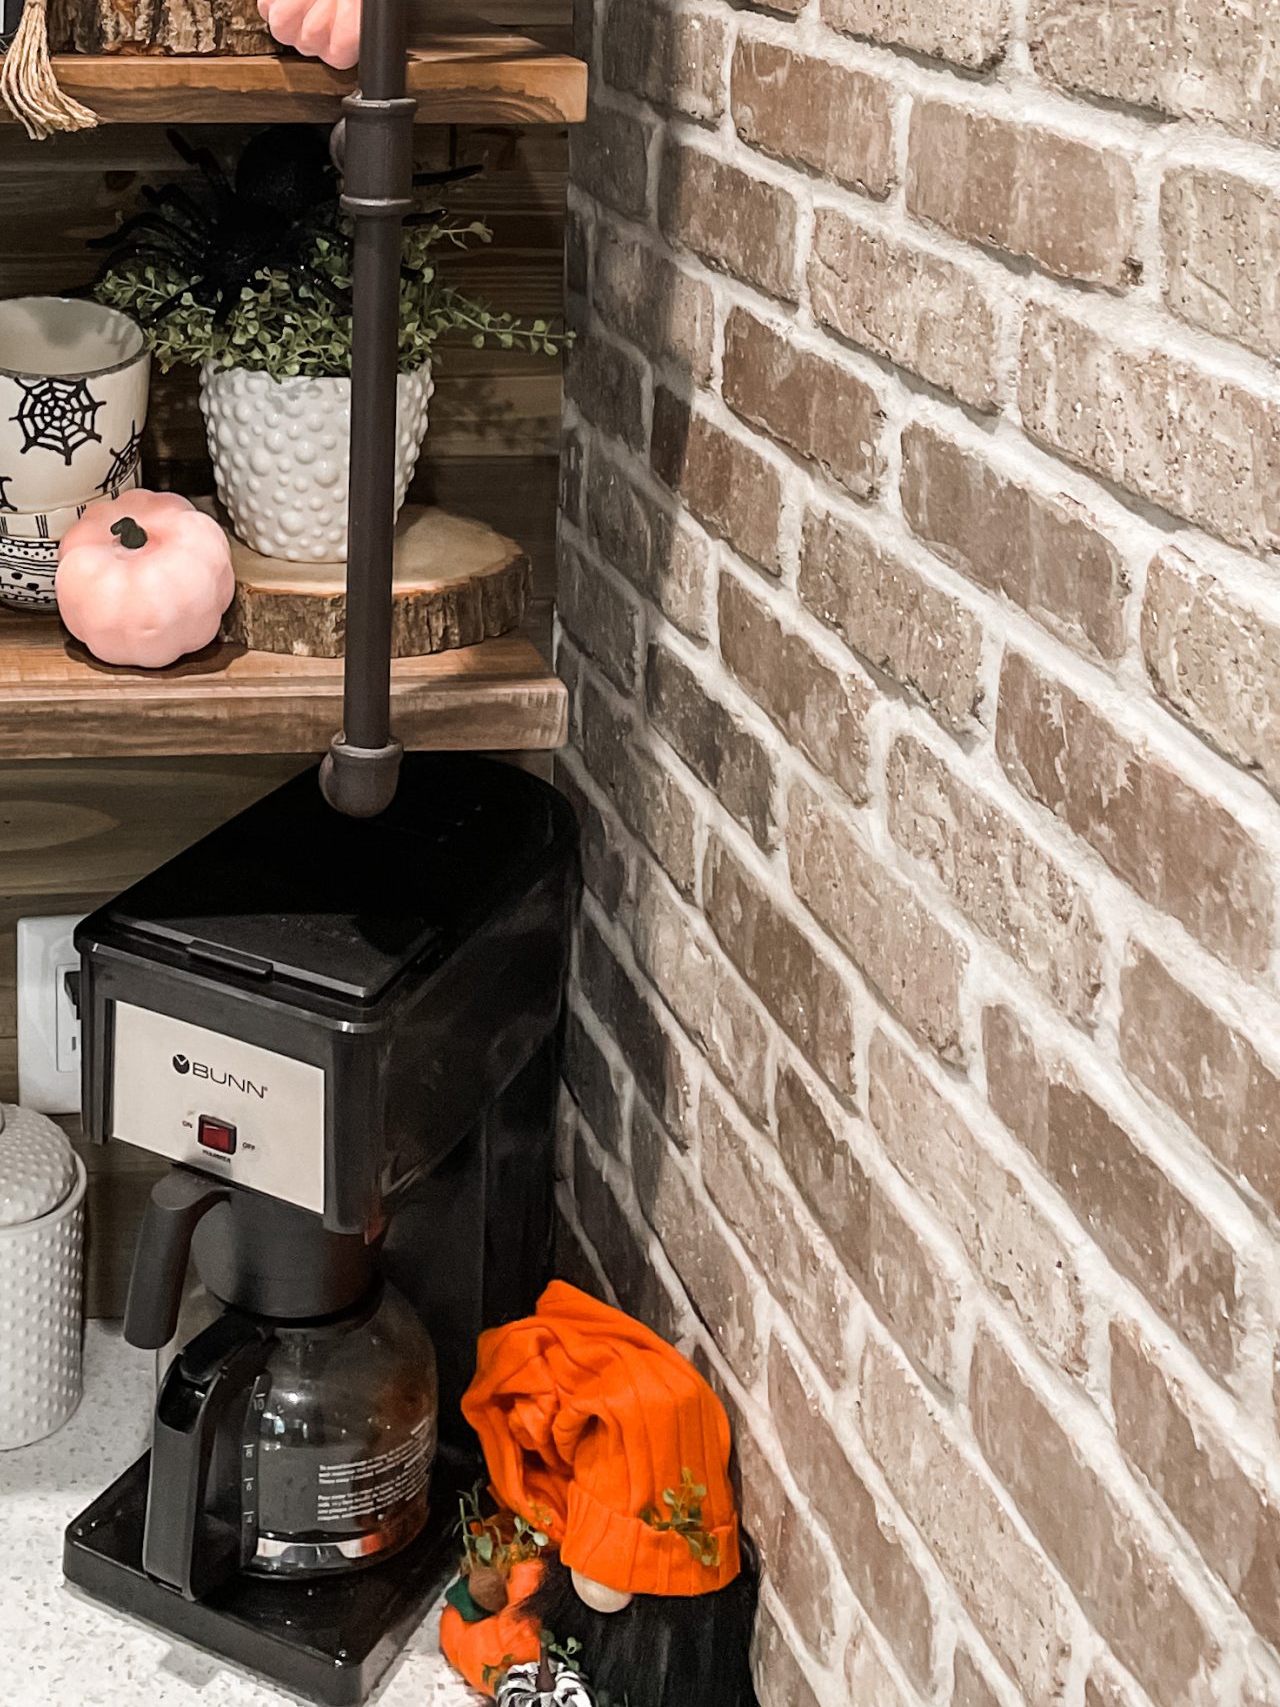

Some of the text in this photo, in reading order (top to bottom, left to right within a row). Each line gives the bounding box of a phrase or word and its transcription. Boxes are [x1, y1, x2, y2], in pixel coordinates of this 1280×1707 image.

[242, 1141, 256, 1151] OFF
[253, 1398, 265, 1411] 10
[245, 1448, 253, 1458] 8
[246, 1482, 253, 1492] 6
